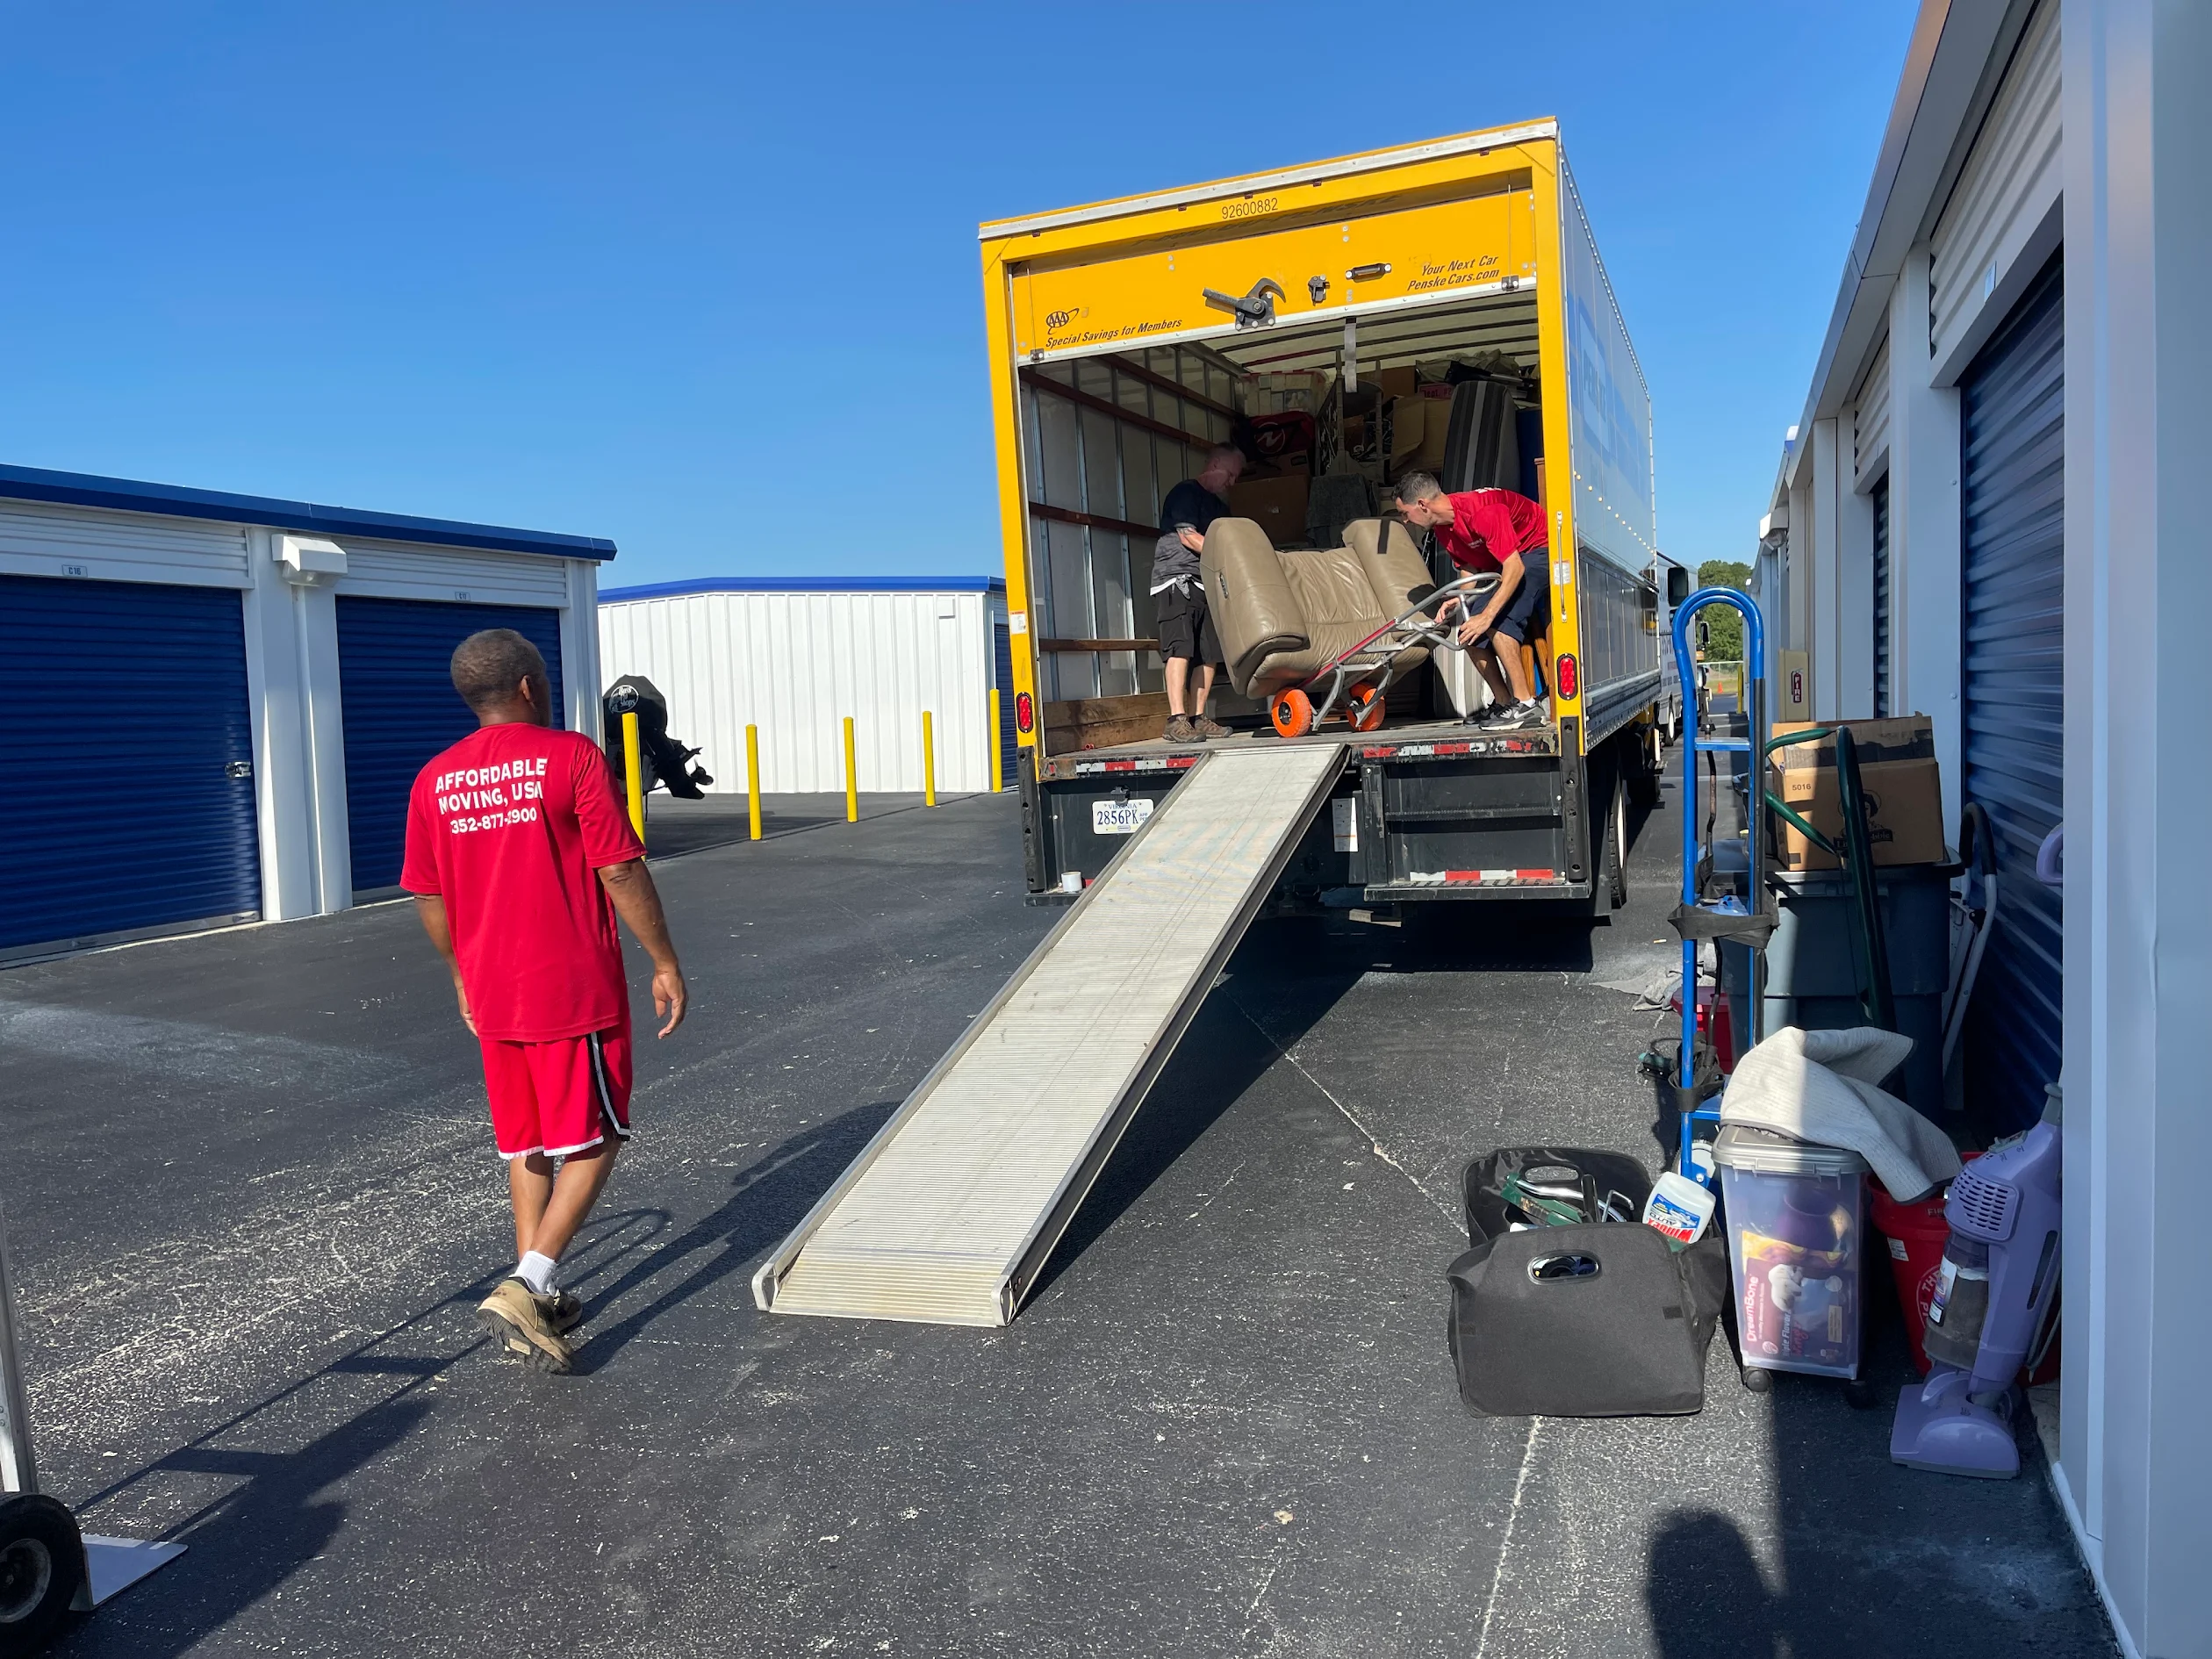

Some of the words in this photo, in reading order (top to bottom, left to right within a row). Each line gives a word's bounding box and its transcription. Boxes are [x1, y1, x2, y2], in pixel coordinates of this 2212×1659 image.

[1222, 198, 1279, 219] 92600882
[1422, 264, 1445, 276] Your
[1447, 260, 1476, 272] Next
[1479, 255, 1499, 266] Car
[1047, 312, 1068, 327] AAA
[1045, 333, 1081, 348] Special
[1082, 329, 1119, 342] Savings
[1121, 326, 1136, 335] for
[1138, 319, 1182, 334] Members
[435, 758, 548, 794] AFFORDABLE
[438, 788, 508, 815] MOVING,
[511, 781, 543, 801] USA
[1097, 809, 1138, 825] 2856PK
[1744, 1275, 1759, 1342] DreamBone
